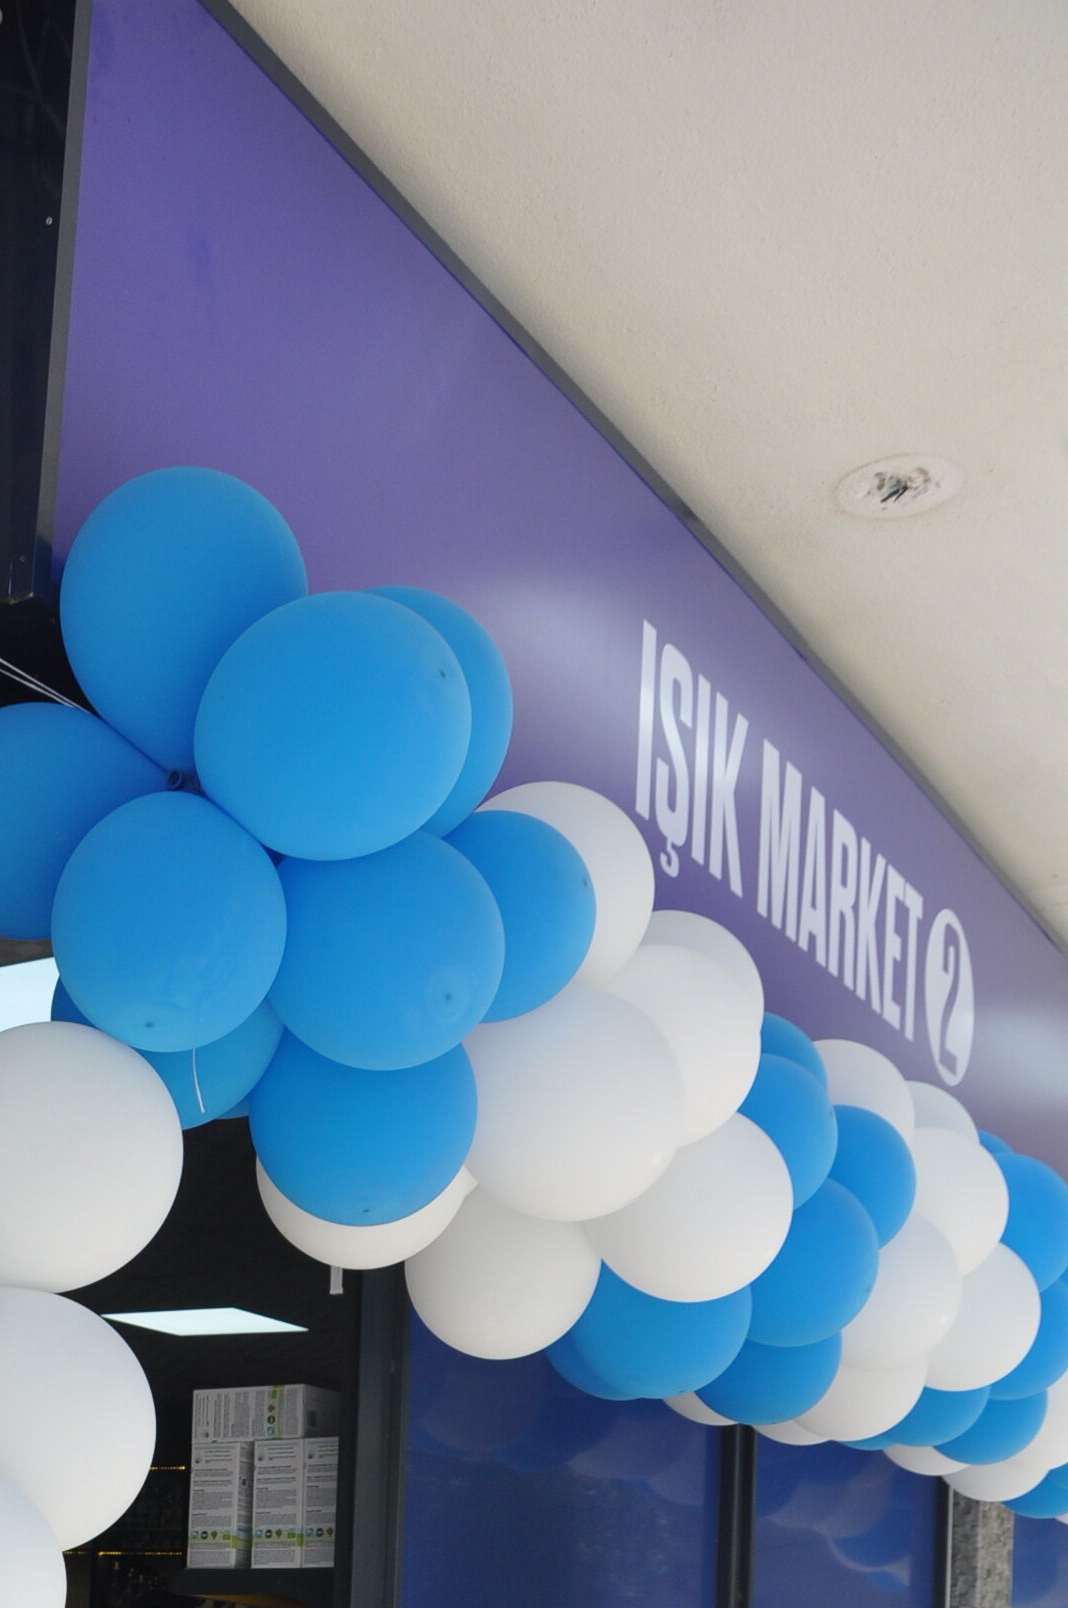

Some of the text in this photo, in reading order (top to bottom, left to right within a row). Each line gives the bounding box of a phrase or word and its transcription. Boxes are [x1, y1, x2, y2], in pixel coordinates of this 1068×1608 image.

[635, 618, 964, 1080] IŞIK MARKET 2
